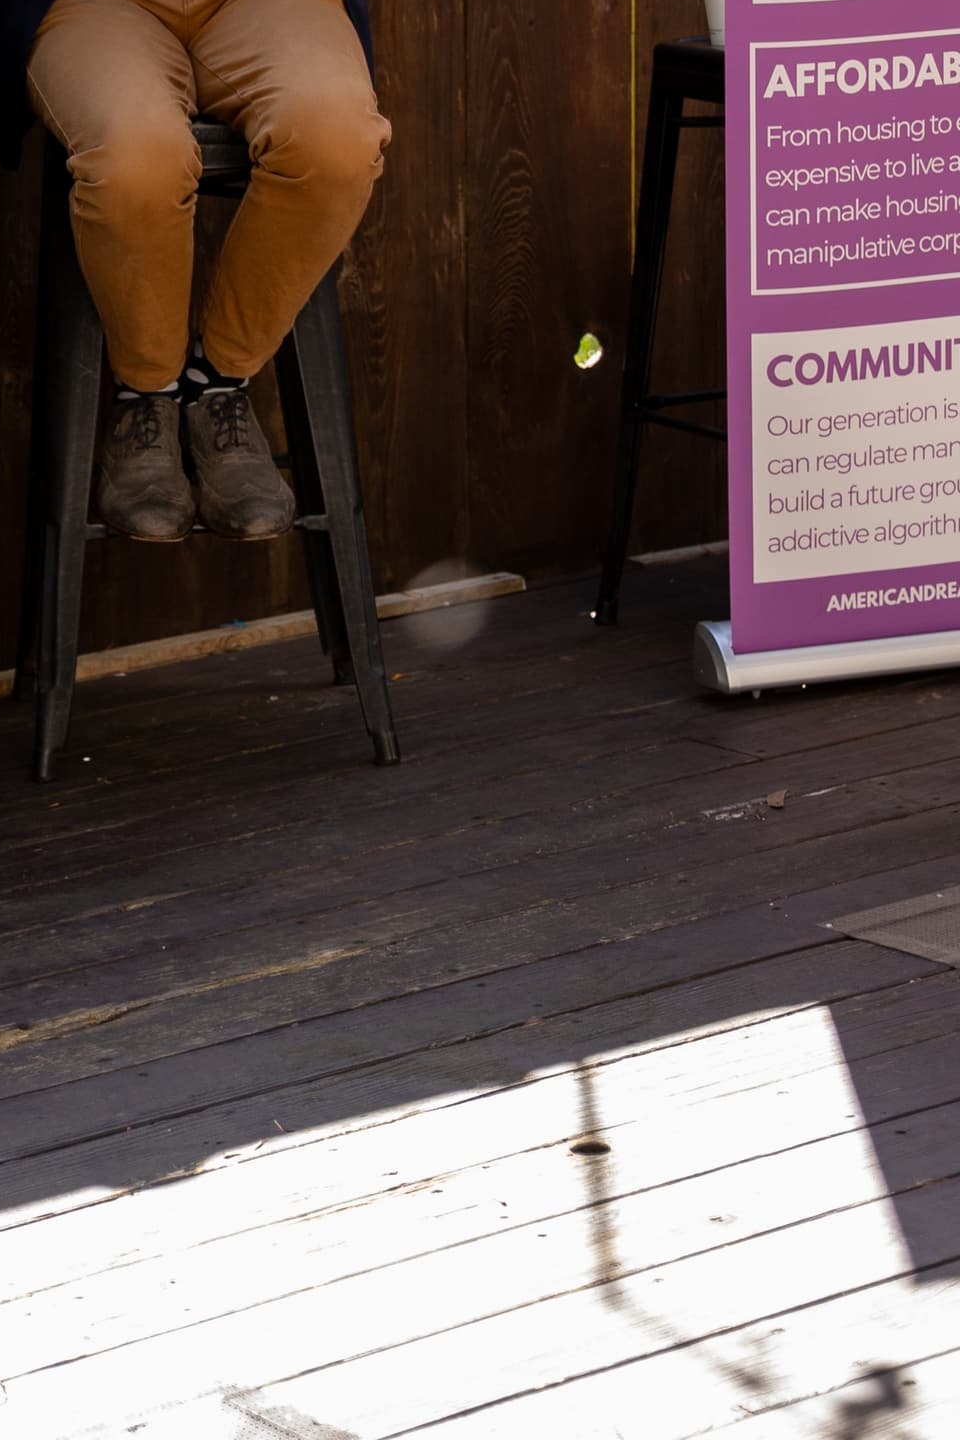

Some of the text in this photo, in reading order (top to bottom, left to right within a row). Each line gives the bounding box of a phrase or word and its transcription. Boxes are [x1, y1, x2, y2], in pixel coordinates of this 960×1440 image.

[763, 51, 960, 98] AFFORDAB
[767, 125, 831, 148] From
[837, 116, 925, 144] housing
[929, 115, 952, 135] to
[765, 160, 880, 191] expensive
[884, 159, 907, 178] to
[911, 153, 945, 176] live
[765, 190, 960, 227] can make housin
[767, 234, 915, 268] manipulative
[767, 398, 958, 438] Our generation is
[767, 456, 810, 475] can
[816, 445, 907, 474] regulate
[768, 479, 960, 514] build a future gro
[768, 513, 960, 553] addictive algorith
[827, 580, 960, 612] AMERICANDRE
